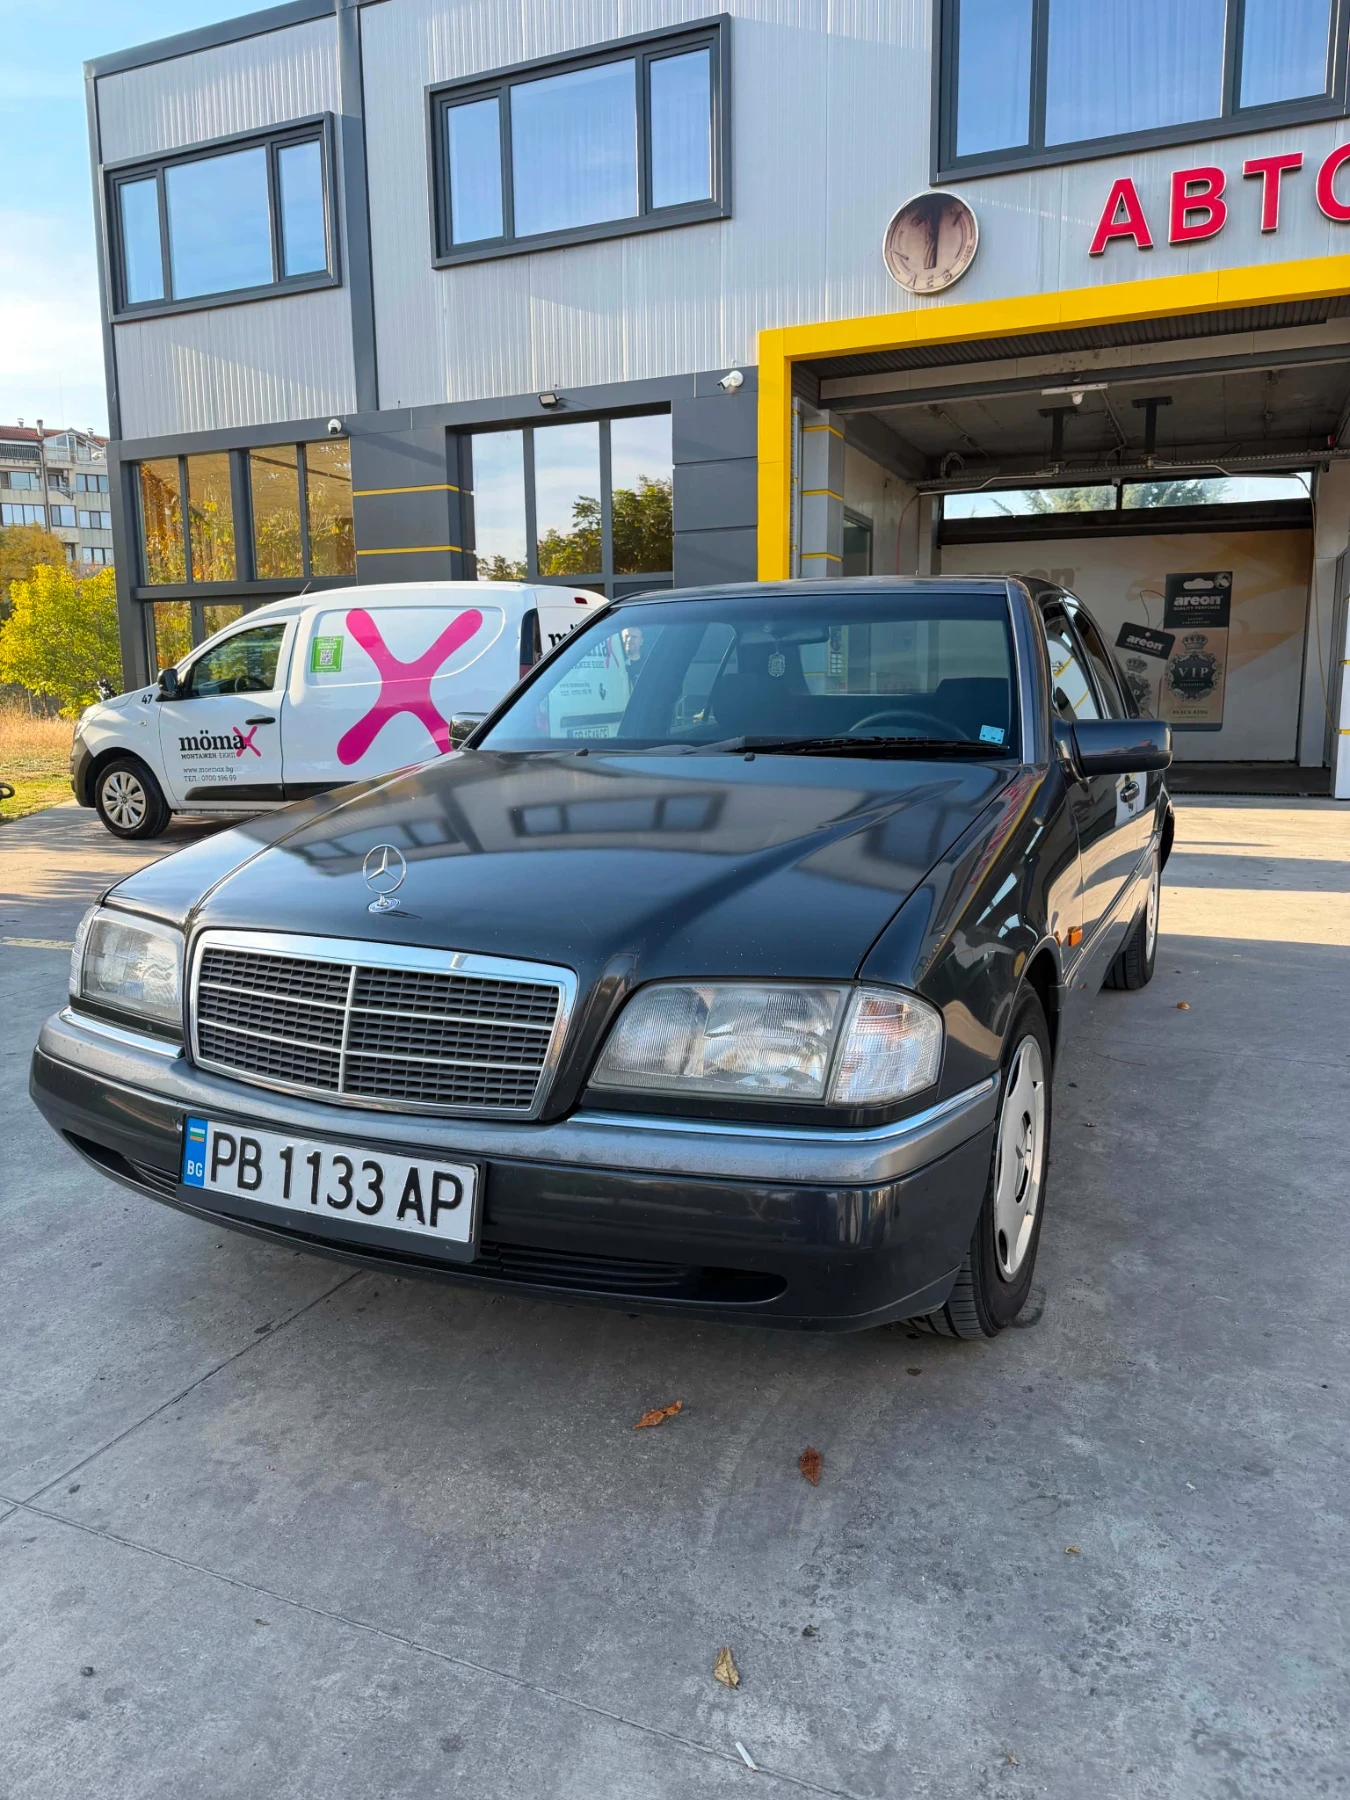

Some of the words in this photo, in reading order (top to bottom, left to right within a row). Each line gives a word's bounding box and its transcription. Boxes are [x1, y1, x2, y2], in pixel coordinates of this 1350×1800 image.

[1173, 595, 1222, 606] areon
[1126, 634, 1163, 651] areon
[1178, 667, 1209, 678] VIP
[142, 694, 153, 705] 47
[179, 725, 261, 758] mömax
[187, 1160, 203, 1178] BG
[210, 1130, 263, 1191] PB
[279, 1144, 384, 1216] 1133
[396, 1166, 464, 1228] AP
